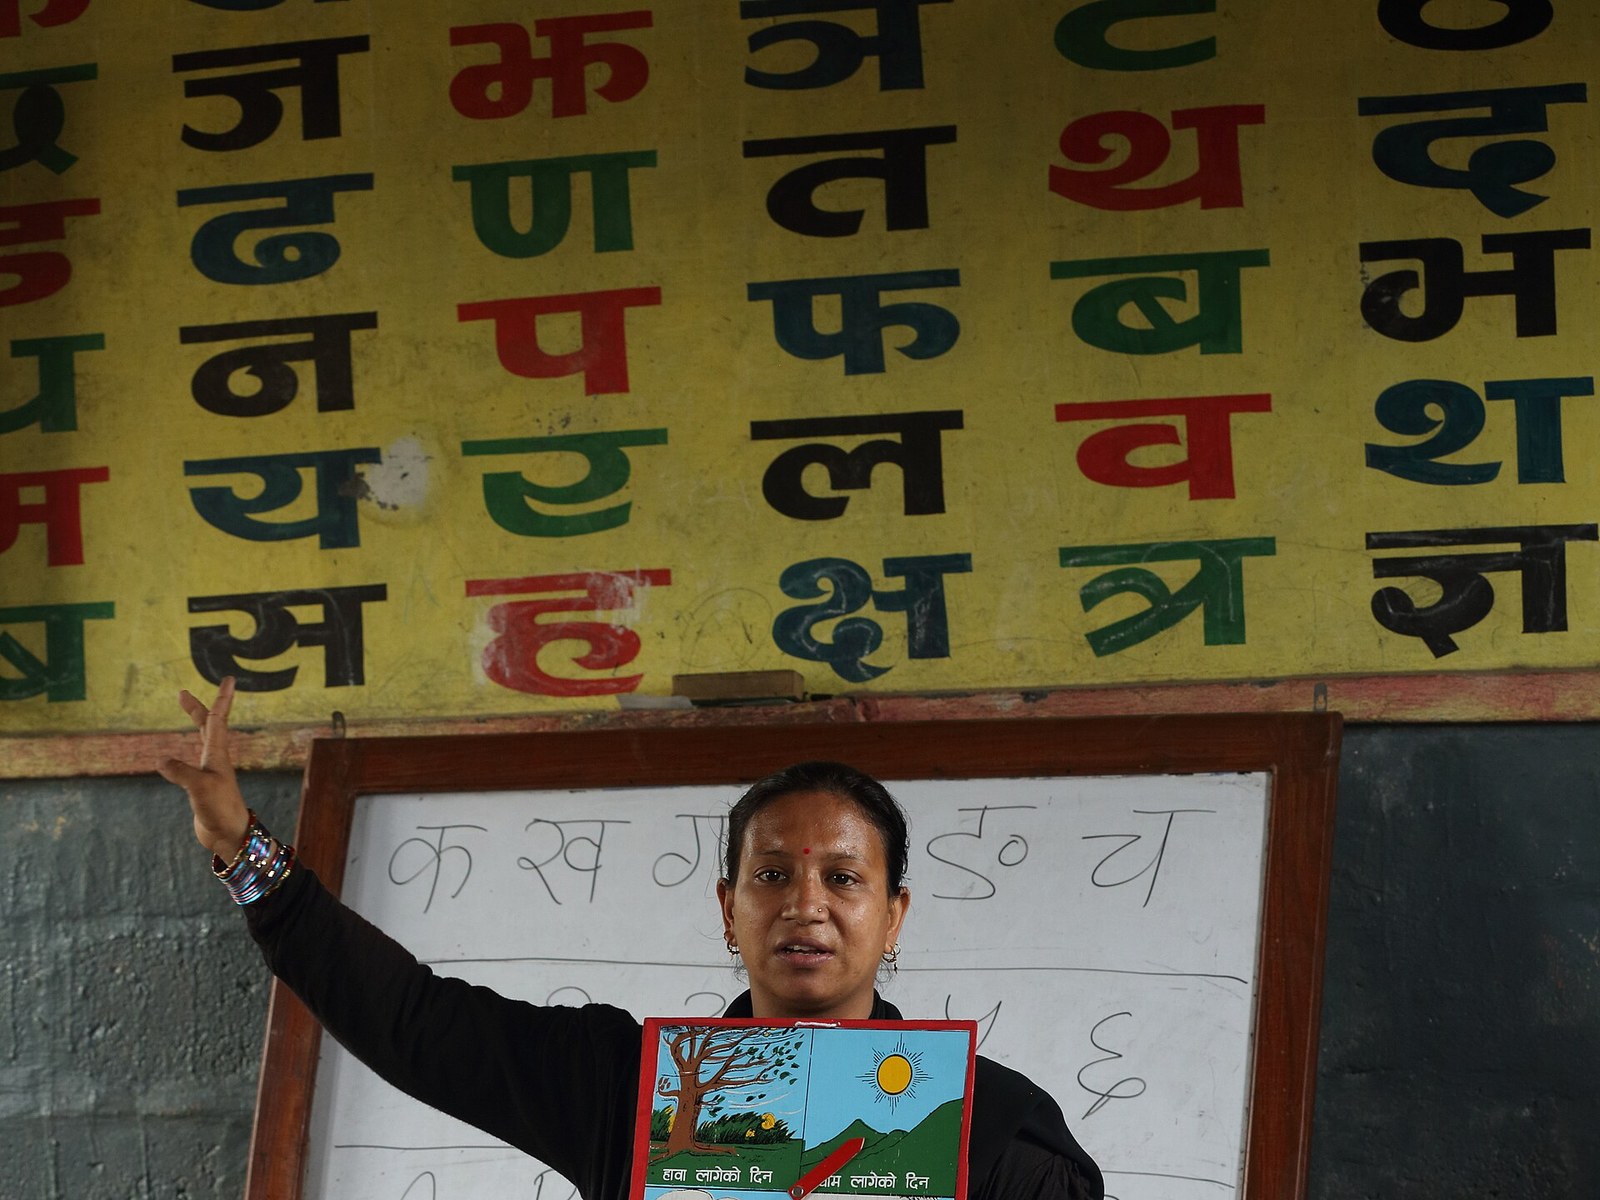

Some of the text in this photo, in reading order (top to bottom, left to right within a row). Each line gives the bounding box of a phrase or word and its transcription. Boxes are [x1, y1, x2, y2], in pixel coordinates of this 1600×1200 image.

[172, 35, 370, 151] ज
[447, 9, 655, 120] झ
[176, 172, 374, 285] ढ
[451, 149, 658, 258] ण
[743, 125, 957, 237] त
[1048, 103, 1266, 212] थ
[1357, 83, 1588, 218] द
[180, 311, 378, 417] न
[456, 286, 662, 396] प
[746, 268, 961, 376] फ
[1050, 249, 1270, 355] ब
[1359, 228, 1591, 342] भ
[183, 447, 382, 550] य
[461, 428, 668, 538] र
[751, 410, 963, 520] ल
[1054, 392, 1272, 501] व
[1364, 375, 1595, 486] श
[187, 584, 388, 692] स
[465, 569, 672, 697] ह
[772, 552, 973, 684] क्ष
[1058, 535, 1277, 657] त्र
[1365, 522, 1600, 658] ज्ञ
[388, 824, 488, 914] क
[517, 818, 632, 905] ख
[652, 814, 730, 888] ग
[662, 1165, 774, 1184] हावा लागेको दिन
[849, 1171, 898, 1189] लागेको
[905, 1171, 931, 1190] दिन
